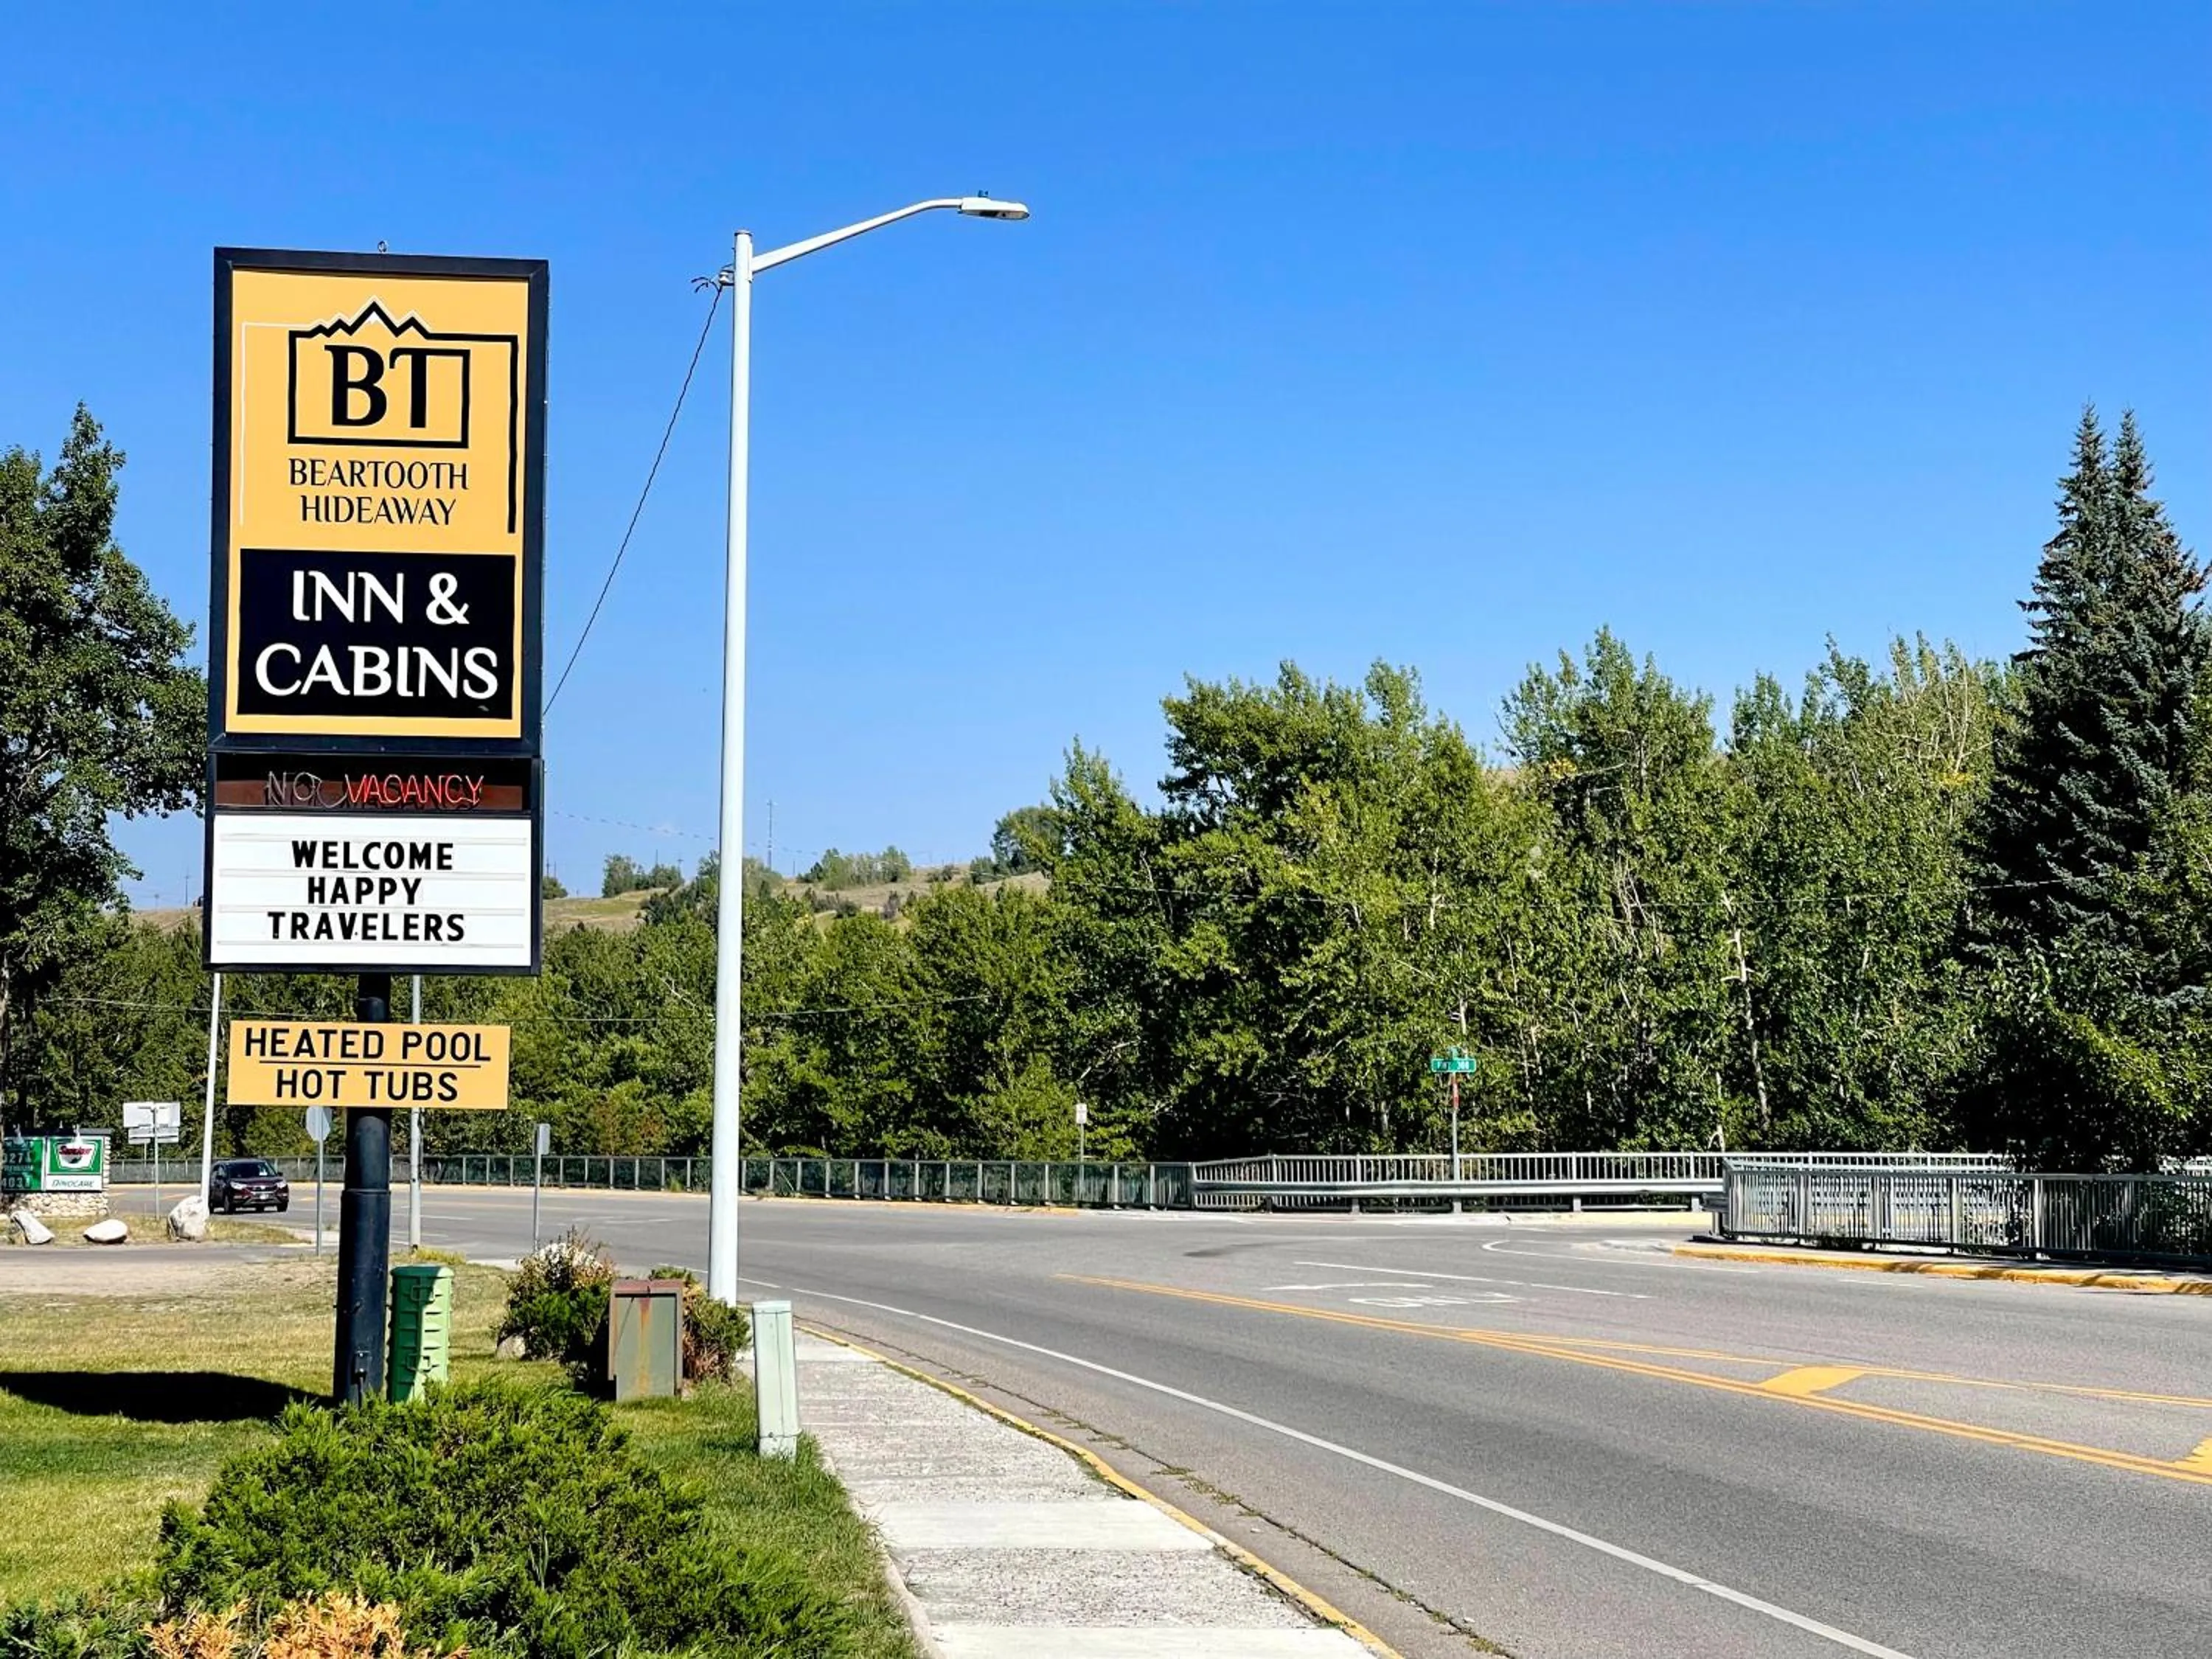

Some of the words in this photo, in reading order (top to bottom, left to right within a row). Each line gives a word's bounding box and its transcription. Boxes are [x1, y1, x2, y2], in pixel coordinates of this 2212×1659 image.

[324, 344, 442, 428] BT
[288, 458, 468, 490] BEARTOOTH
[300, 495, 456, 526] HIDEAWAY
[293, 570, 404, 624] INN
[425, 572, 470, 625] &
[255, 642, 498, 700] CABINS
[266, 771, 316, 801] NO
[344, 773, 484, 804] VACANCY
[291, 840, 454, 871] WELCOME
[307, 876, 422, 905] HAPPY
[267, 911, 465, 942] TRAVELERS
[245, 1027, 384, 1060] HEATED
[402, 1031, 492, 1062] POOL
[276, 1068, 347, 1099] HOT
[364, 1071, 459, 1102] TUBS
